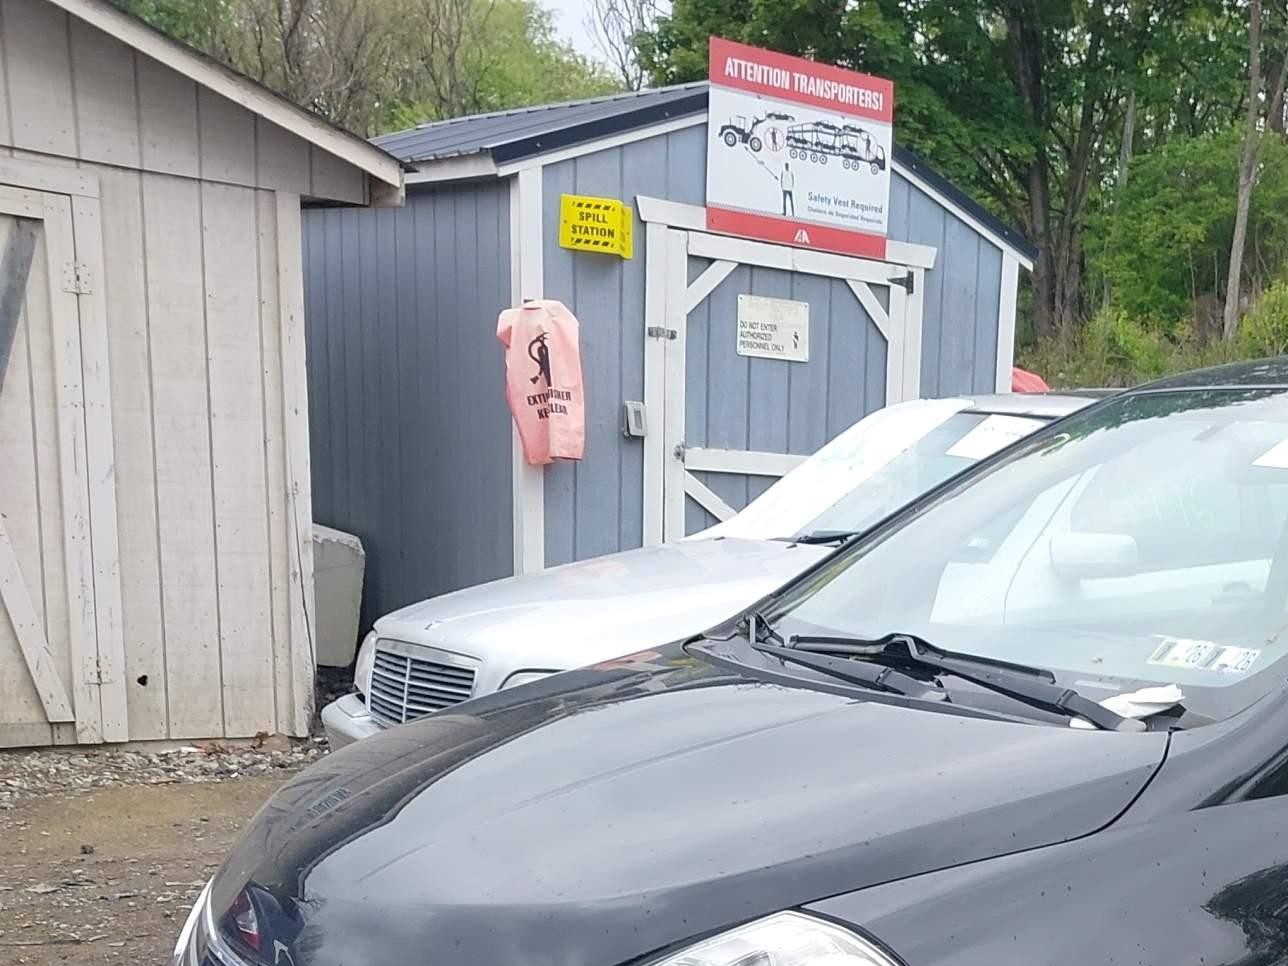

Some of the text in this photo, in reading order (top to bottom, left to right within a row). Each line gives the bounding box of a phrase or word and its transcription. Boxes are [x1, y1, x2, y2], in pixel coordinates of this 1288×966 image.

[725, 57, 883, 111] ATTENTION TRANSPORTERS!
[808, 191, 883, 214] Safety Vest Required
[579, 211, 608, 224] SPILL
[571, 224, 615, 239] STATION
[740, 320, 778, 333] DO NOT ENTER
[740, 331, 773, 341] AUTHORIZED
[740, 341, 785, 353] PERSONNEL ONLY
